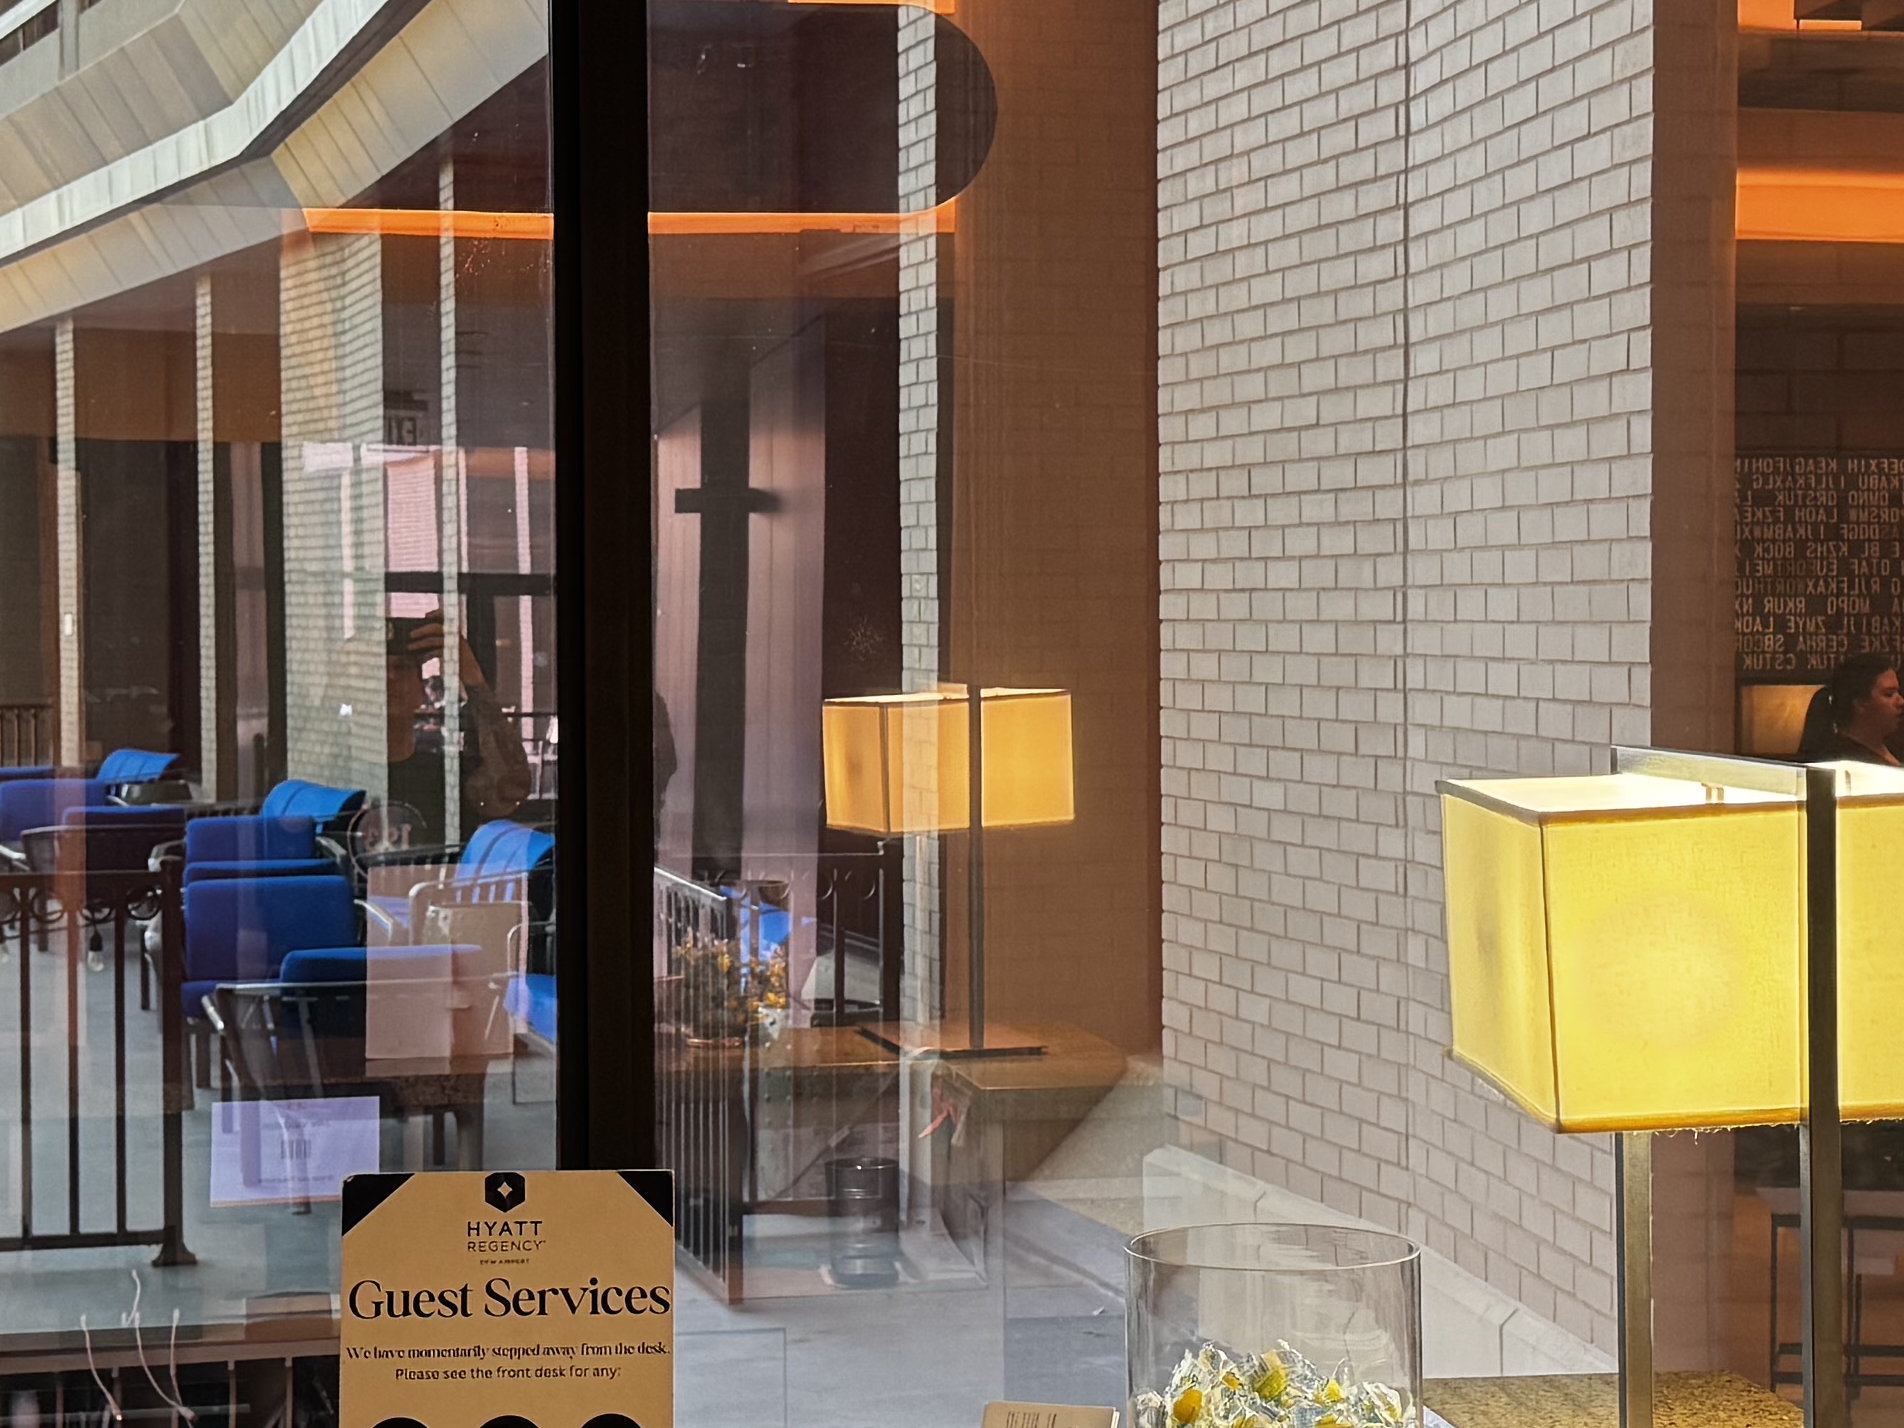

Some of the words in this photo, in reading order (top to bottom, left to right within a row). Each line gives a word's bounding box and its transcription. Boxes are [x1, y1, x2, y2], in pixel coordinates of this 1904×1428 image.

[467, 1221, 543, 1237] HYATT
[467, 1240, 543, 1253] REGENCY
[348, 1279, 473, 1320] Guest
[484, 1277, 671, 1318] Services
[346, 1346, 371, 1359] We
[374, 1345, 405, 1359] have
[407, 1344, 489, 1360] momentarily
[492, 1344, 540, 1360] stepped
[543, 1346, 578, 1360] away
[581, 1343, 612, 1356] from
[615, 1342, 635, 1355] the
[395, 1368, 440, 1380] Please
[442, 1370, 466, 1380] see
[470, 1367, 493, 1379] the
[496, 1366, 531, 1379] front
[534, 1365, 566, 1378] desk
[569, 1365, 590, 1378] for
